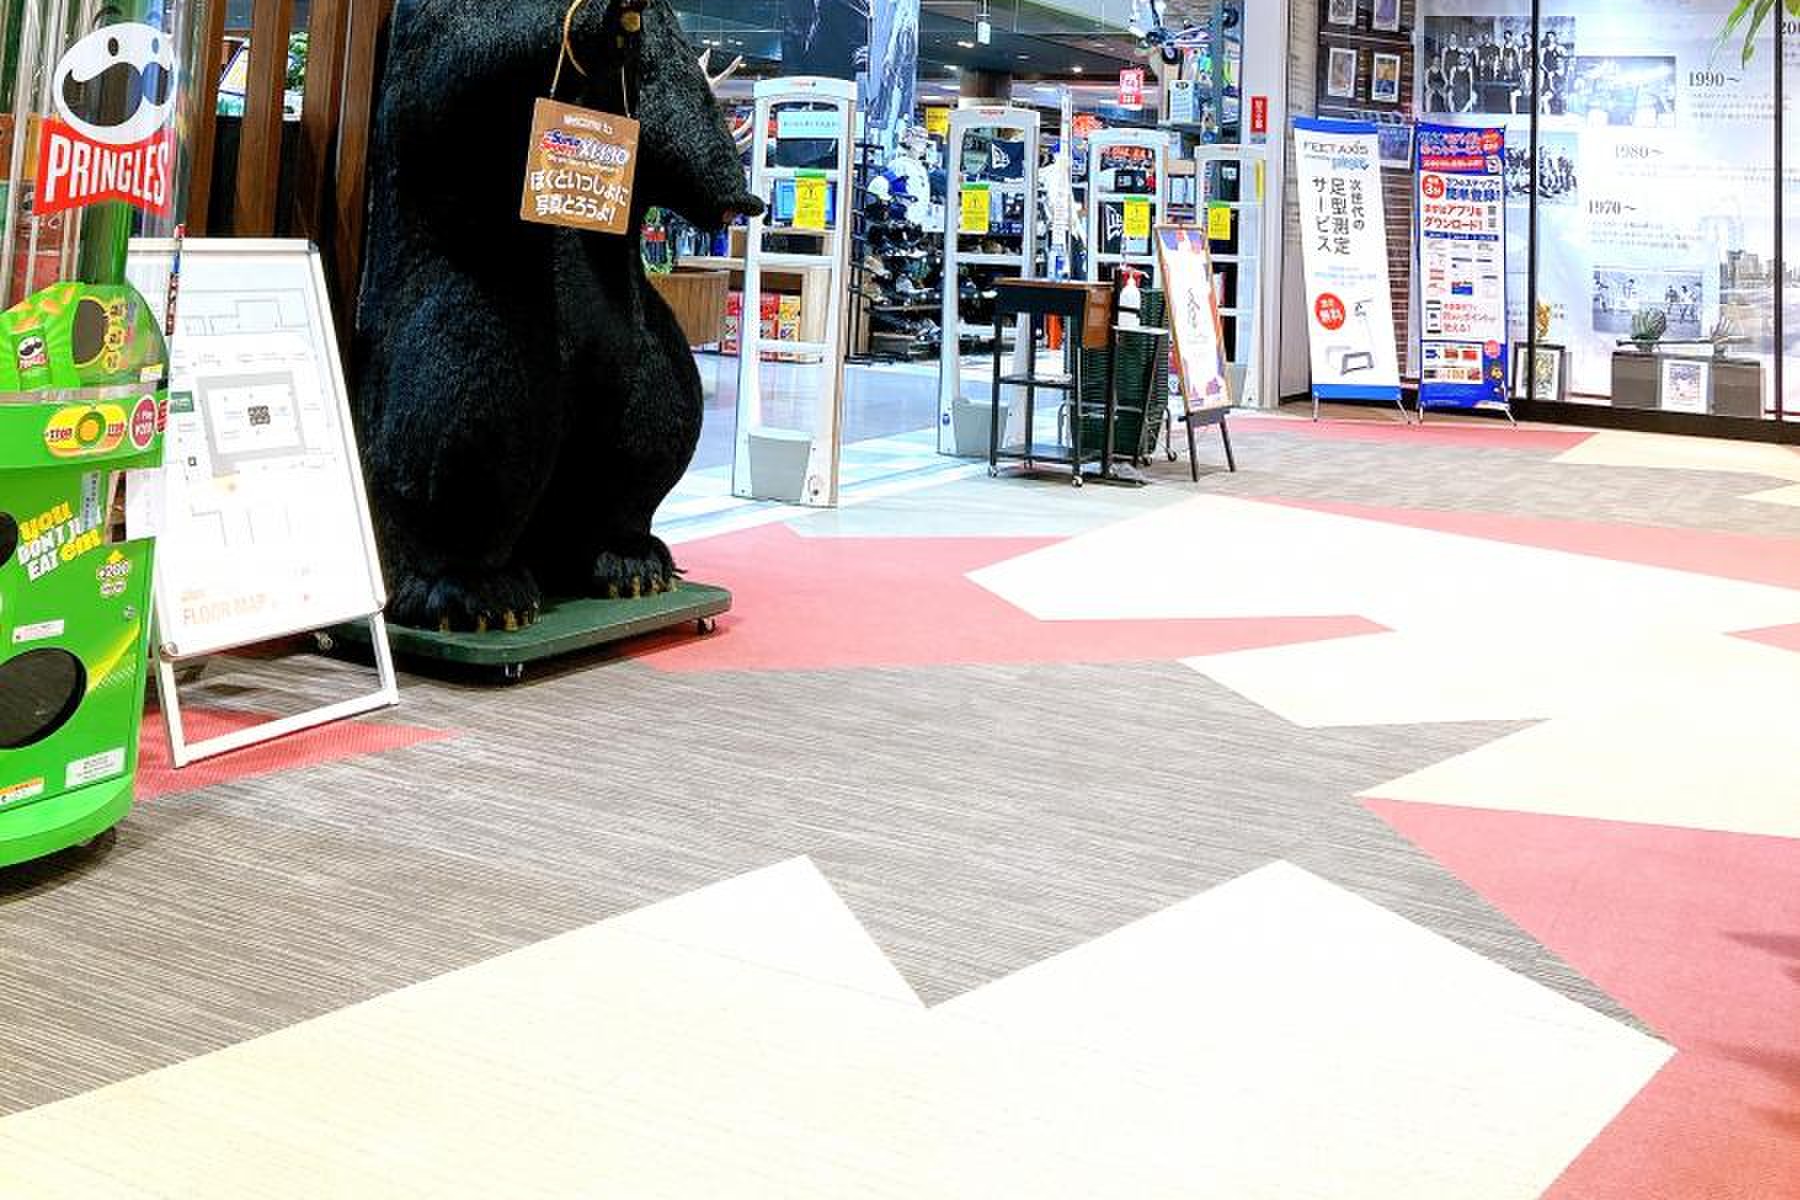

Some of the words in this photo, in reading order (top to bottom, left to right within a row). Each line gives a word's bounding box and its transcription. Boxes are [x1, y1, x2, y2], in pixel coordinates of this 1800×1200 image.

[1781, 21, 1800, 36] 20
[44, 132, 169, 207] PRINGLES
[531, 169, 629, 207] ぼくといっしょに
[1312, 177, 1331, 253] サービス
[1330, 178, 1351, 255] 足型測定
